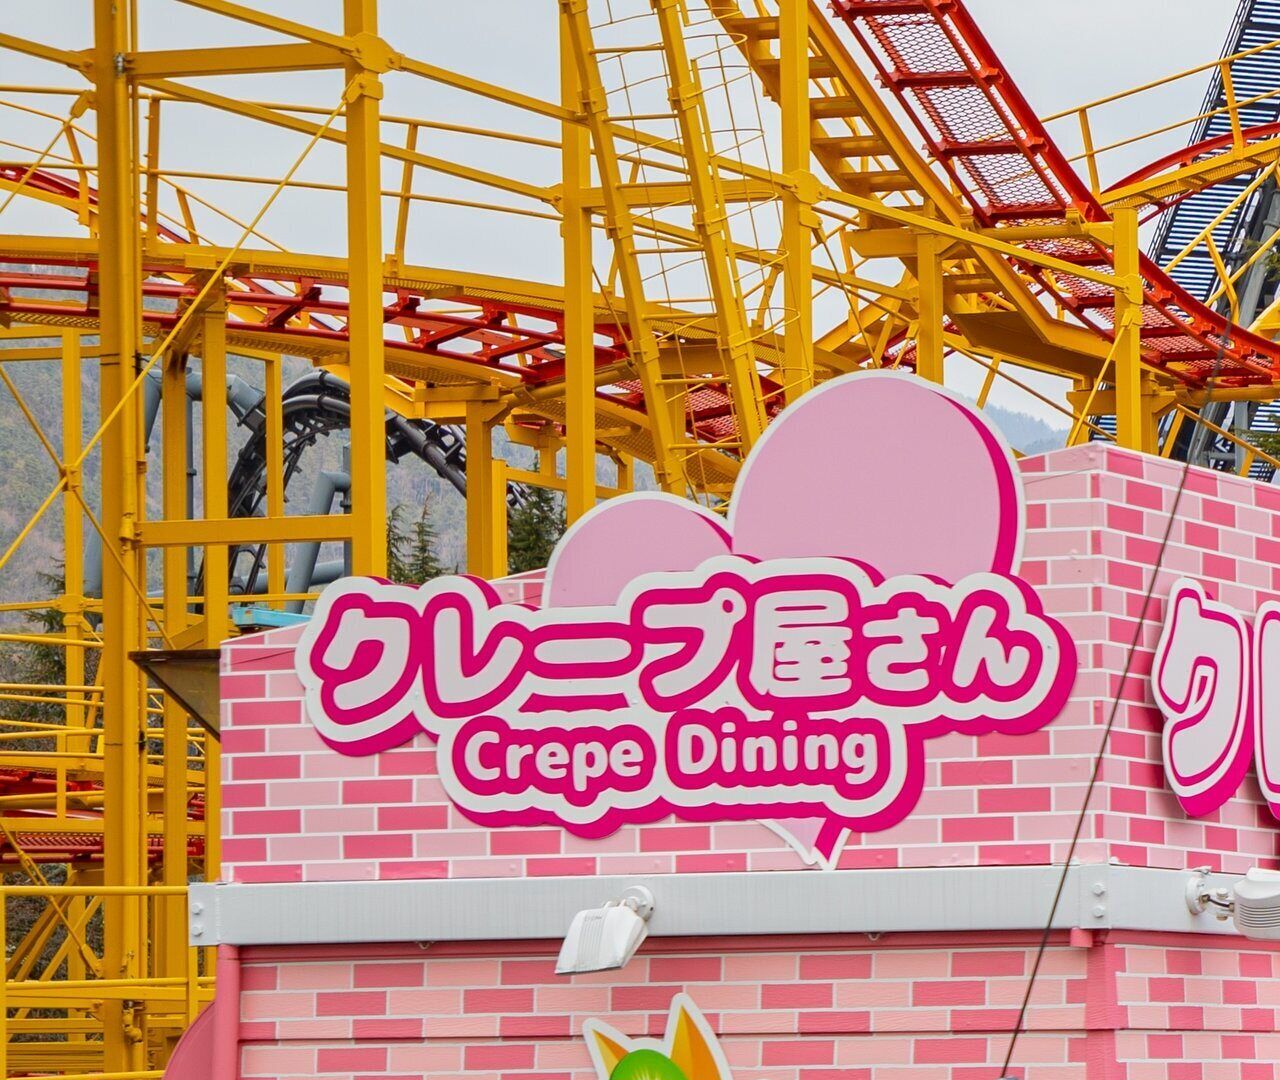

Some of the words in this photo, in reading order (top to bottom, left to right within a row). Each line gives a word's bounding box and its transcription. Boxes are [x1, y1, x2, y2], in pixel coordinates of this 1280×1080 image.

[321, 587, 1033, 712] クレープ屋さん
[462, 727, 643, 791] Crepe
[676, 720, 879, 786] Dining
